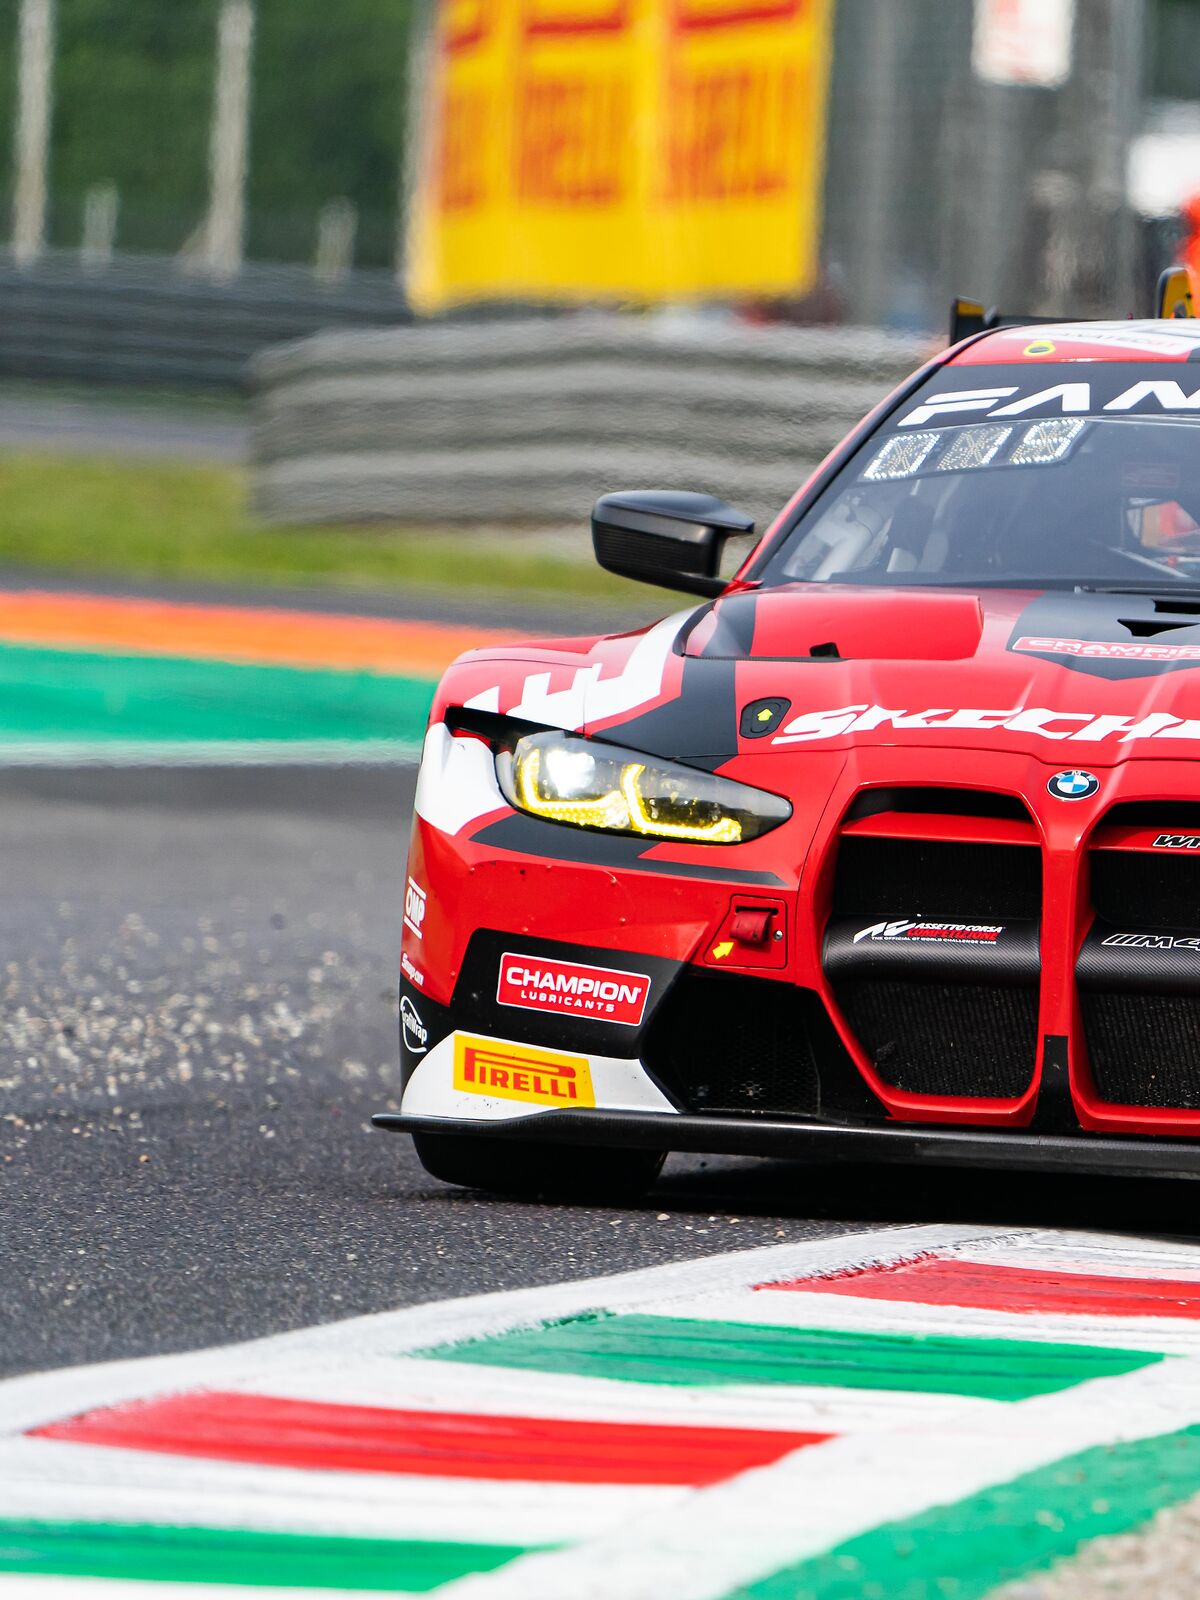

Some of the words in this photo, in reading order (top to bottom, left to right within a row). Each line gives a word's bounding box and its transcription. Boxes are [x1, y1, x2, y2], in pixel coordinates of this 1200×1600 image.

[915, 923, 966, 931] ASSETTO
[965, 925, 1003, 933] CORSA
[505, 966, 639, 1005] CHAMPION
[520, 989, 616, 1013] LUBRICANTS
[463, 1046, 577, 1099] PIRELLI
